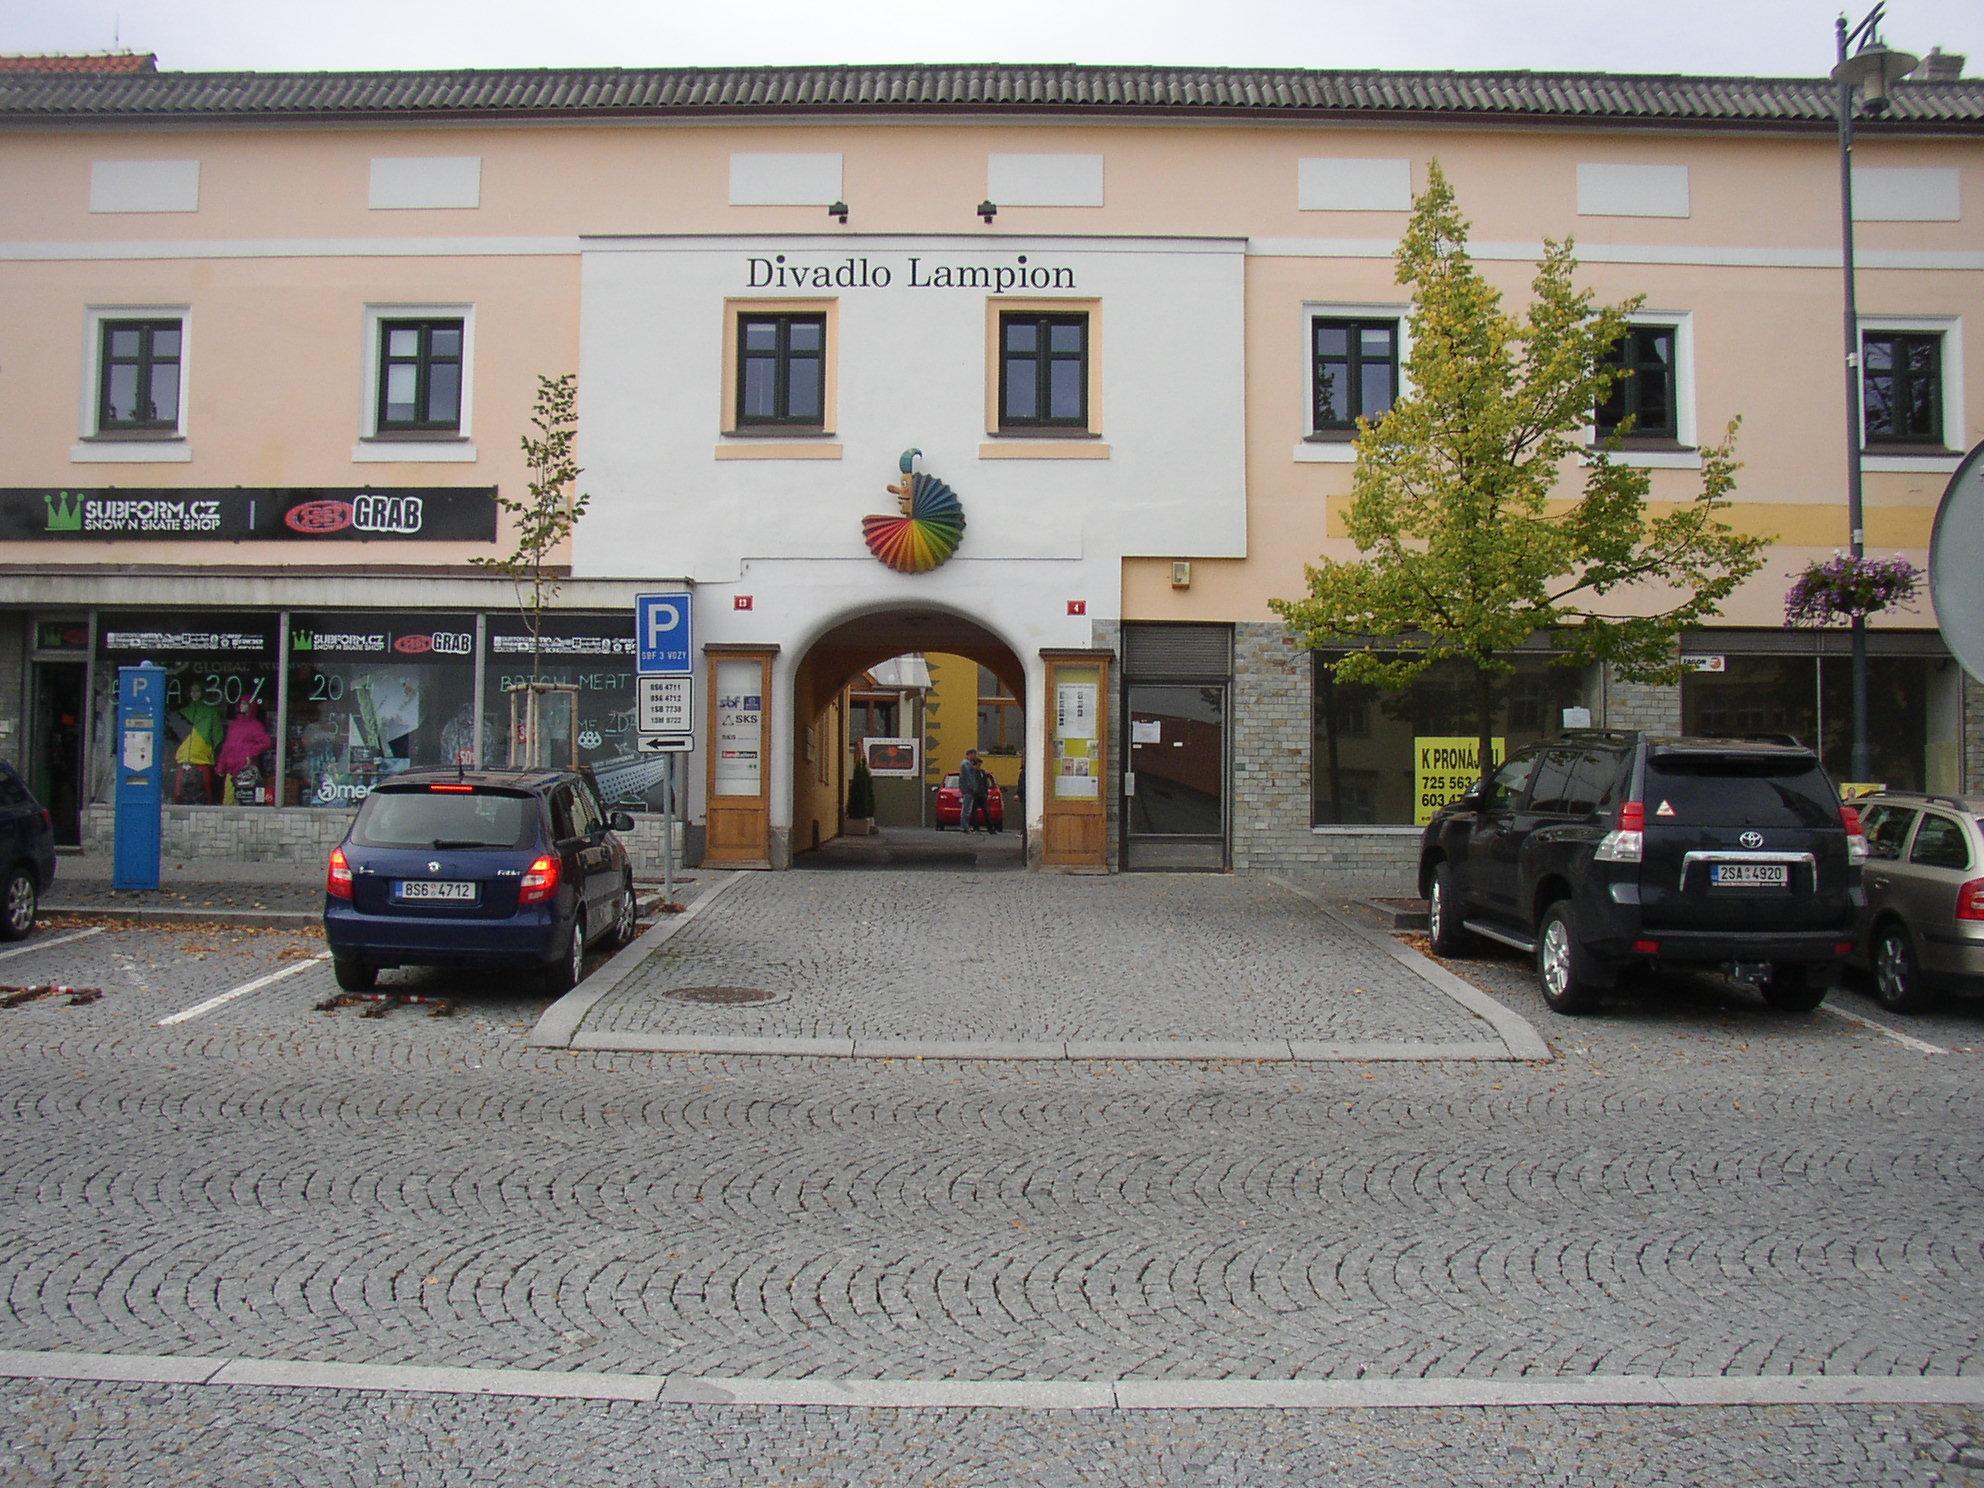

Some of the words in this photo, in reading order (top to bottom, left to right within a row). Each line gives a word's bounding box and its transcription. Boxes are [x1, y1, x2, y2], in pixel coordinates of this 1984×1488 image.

[746, 255, 892, 289] Divadlo
[907, 255, 1076, 294] Lampion
[85, 500, 221, 519] SUBFORM.CZ
[353, 495, 422, 533] GRAB
[84, 519, 125, 531] SNOW
[128, 519, 139, 531] N
[141, 519, 180, 531] SKATE
[183, 519, 221, 531] SHOP
[648, 604, 680, 649] P
[432, 632, 472, 654] GRAB
[133, 678, 148, 697] P
[735, 714, 758, 724] SKS
[1422, 748, 1431, 769] K
[1422, 776, 1445, 790] 725
[1449, 776, 1472, 790] 563
[1421, 793, 1445, 807] 603
[1720, 866, 1743, 880] 2SA
[1752, 866, 1782, 880] 4920
[405, 883, 430, 897] 8S6
[438, 883, 471, 898] 4712
